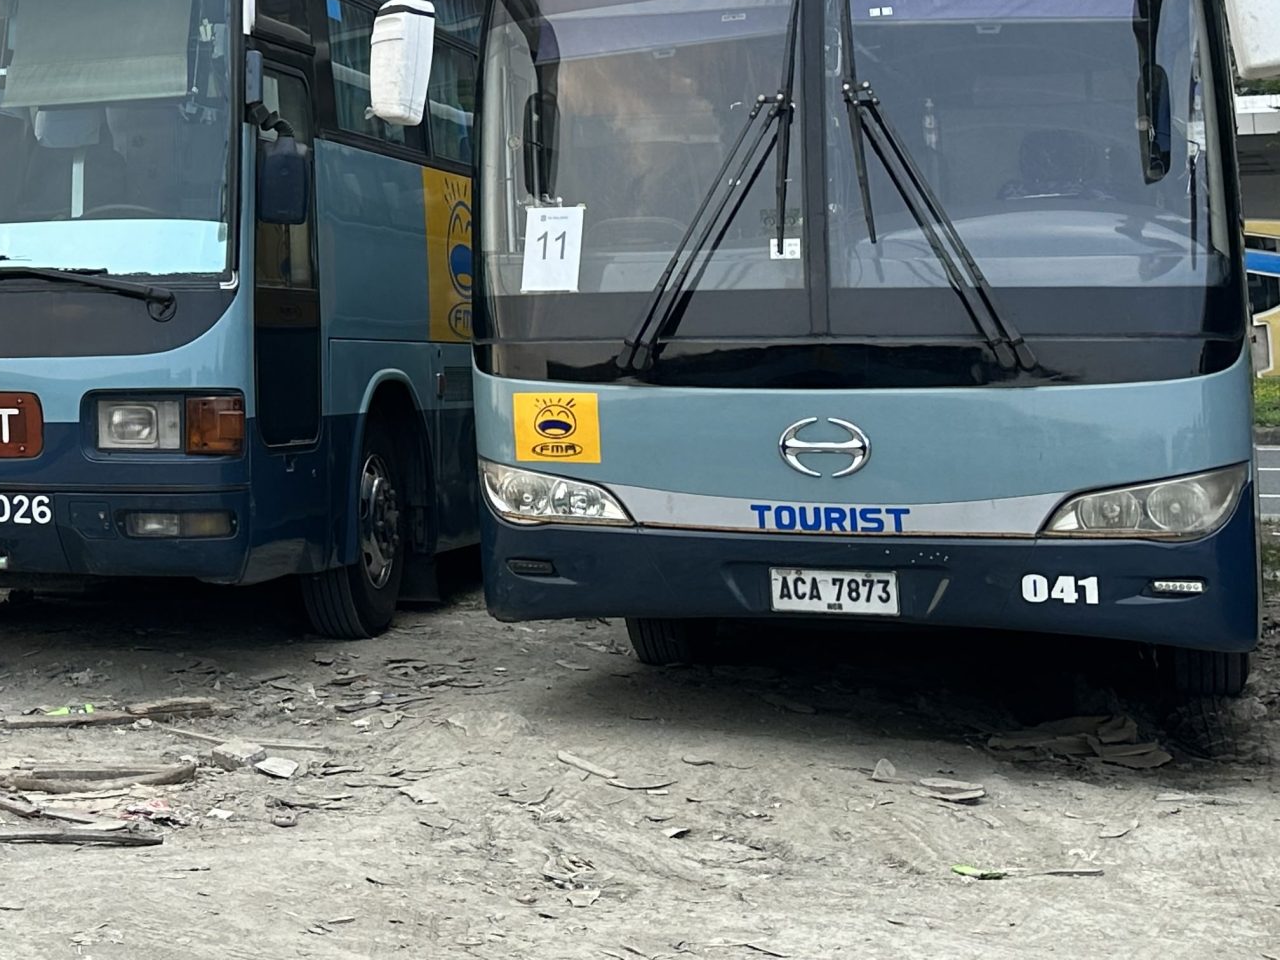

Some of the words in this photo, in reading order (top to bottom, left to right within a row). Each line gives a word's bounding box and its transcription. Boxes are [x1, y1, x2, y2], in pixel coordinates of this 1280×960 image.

[537, 230, 566, 260] 11
[750, 504, 911, 533] TOURIST
[779, 576, 822, 602] ACA
[831, 578, 891, 603] 7873
[1021, 574, 1099, 604] 041
